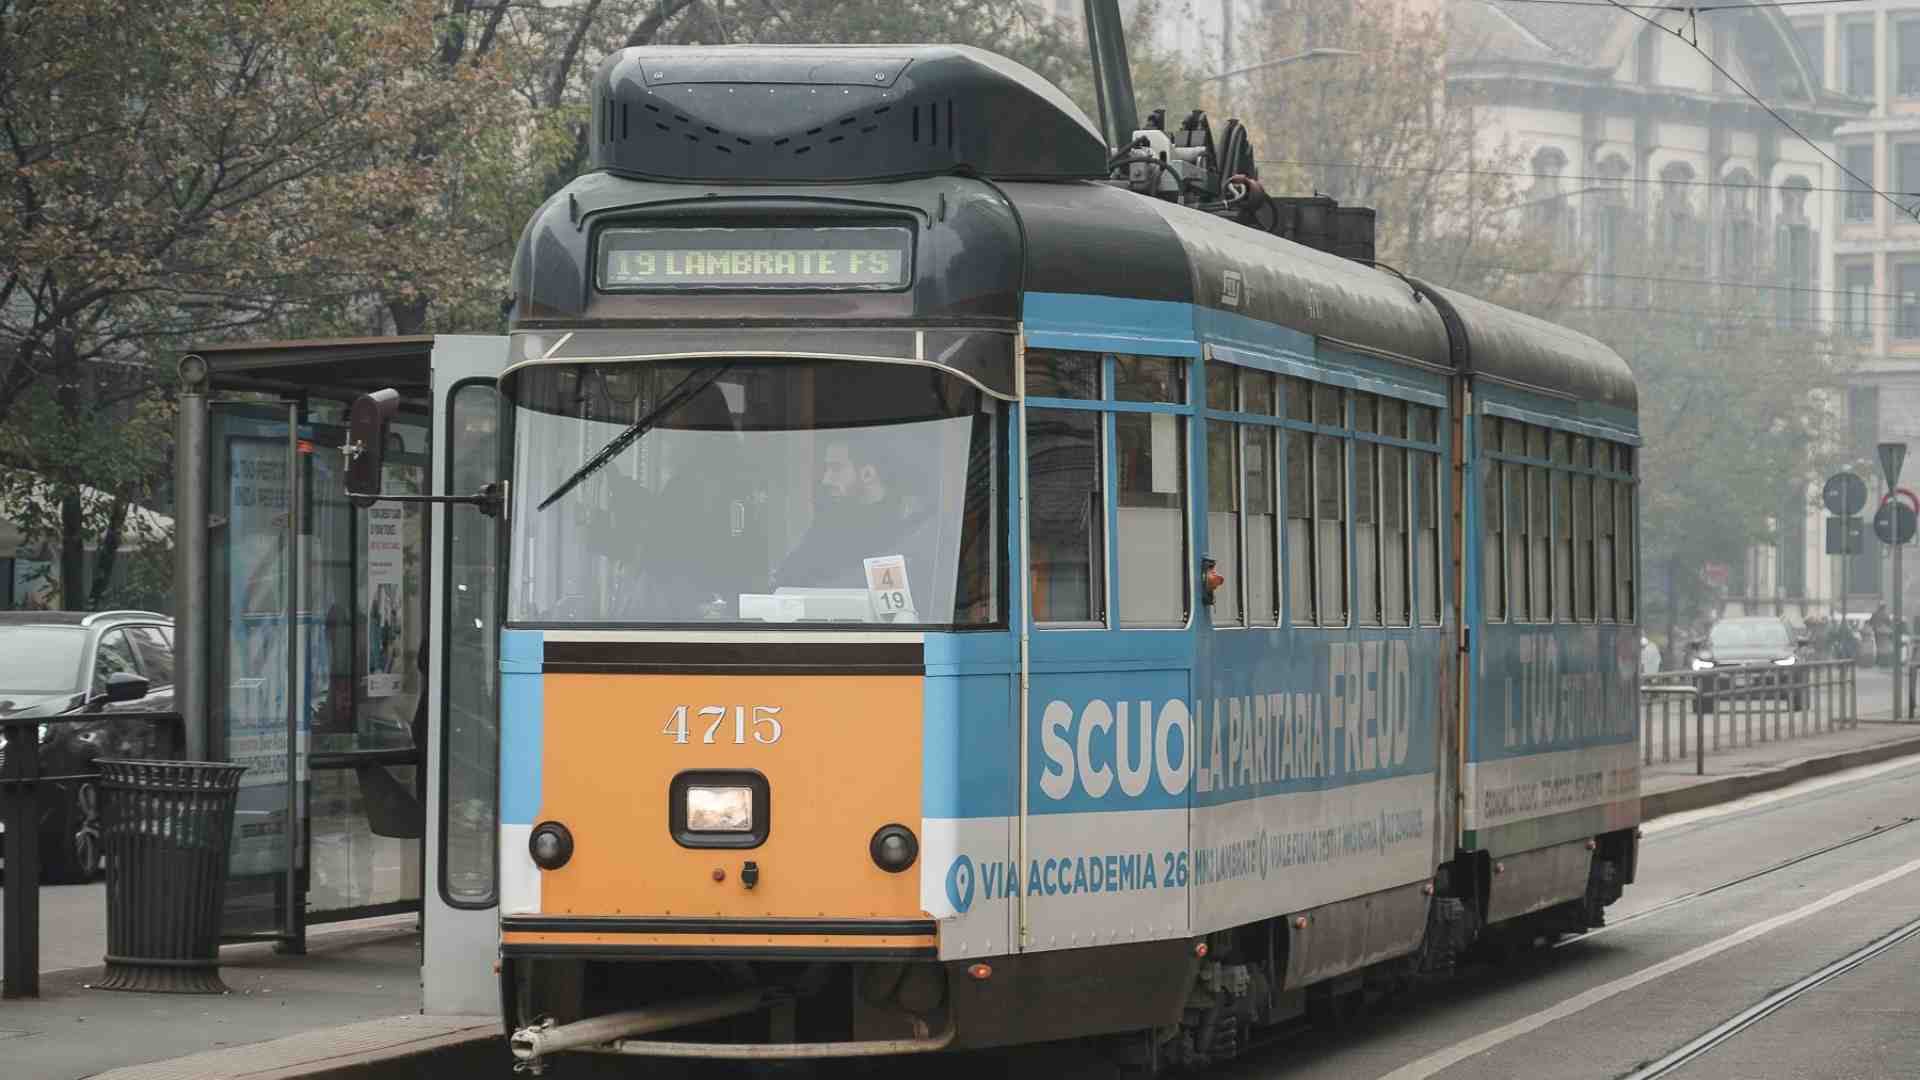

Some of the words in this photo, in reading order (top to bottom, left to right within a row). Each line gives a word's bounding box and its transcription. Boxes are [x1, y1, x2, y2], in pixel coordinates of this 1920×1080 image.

[616, 251, 656, 275] 19
[666, 250, 836, 276] LAMBRATE
[849, 251, 890, 275] FS
[881, 568, 895, 589] 4
[880, 592, 905, 610] 19
[663, 705, 783, 744] 4715
[1228, 692, 1326, 788] PARITARIA
[1328, 639, 1410, 776] FREUD
[980, 860, 1020, 900] VIA
[1027, 851, 1158, 897] ACCADEMIA
[1163, 850, 1188, 888] 26
